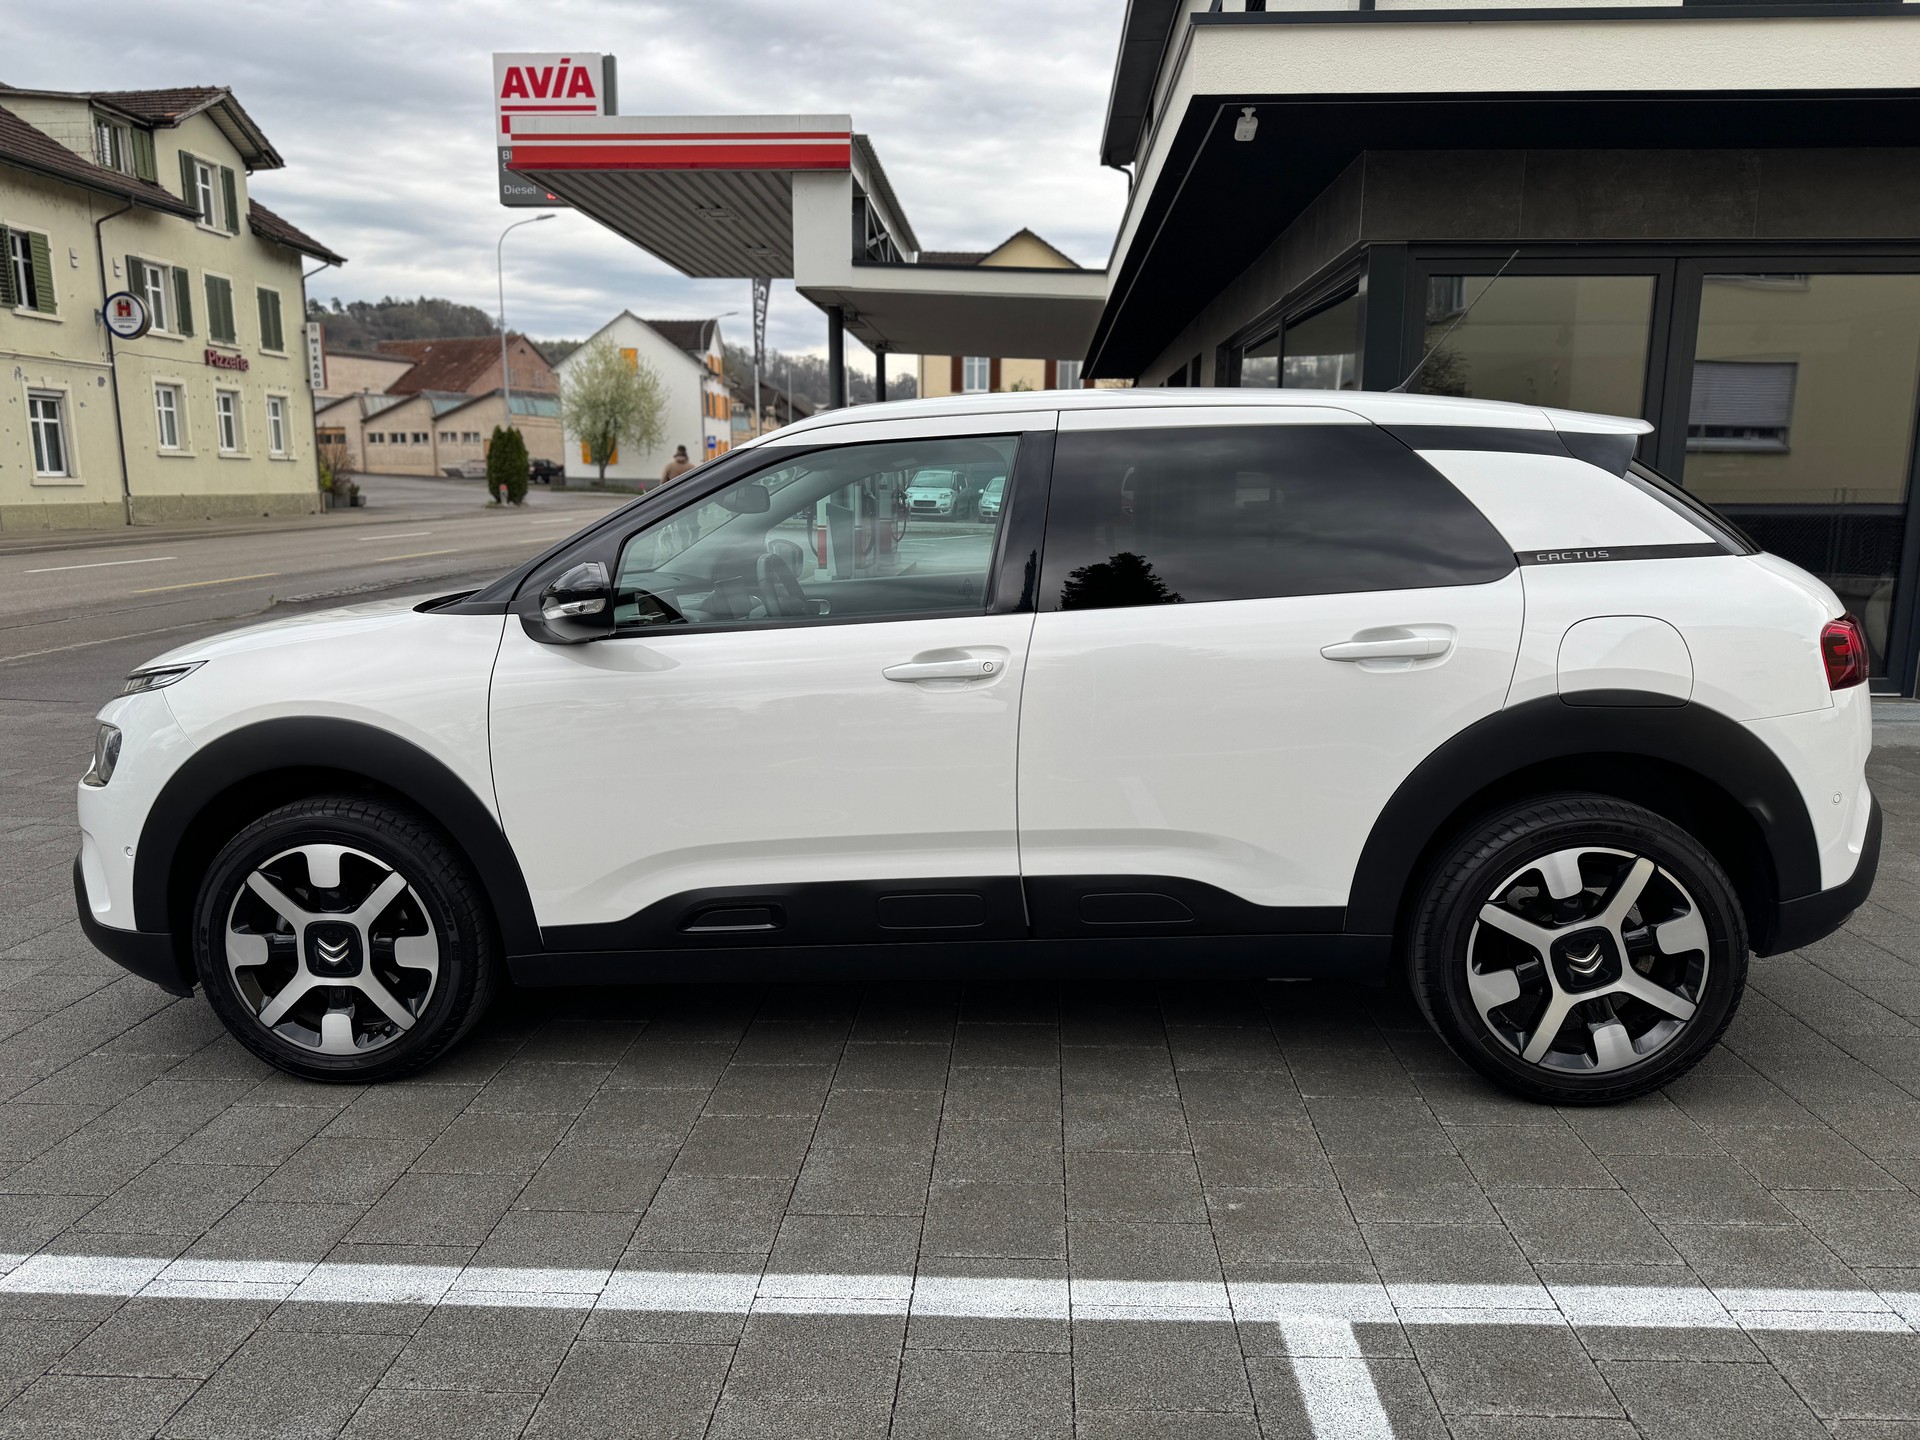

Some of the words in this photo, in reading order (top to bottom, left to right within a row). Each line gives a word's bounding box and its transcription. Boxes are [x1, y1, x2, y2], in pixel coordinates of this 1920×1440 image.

[504, 185, 536, 194] Diesel
[207, 350, 249, 371] Pizzeria
[310, 338, 321, 387] MIKADO
[1536, 550, 1610, 562] CACTUS
